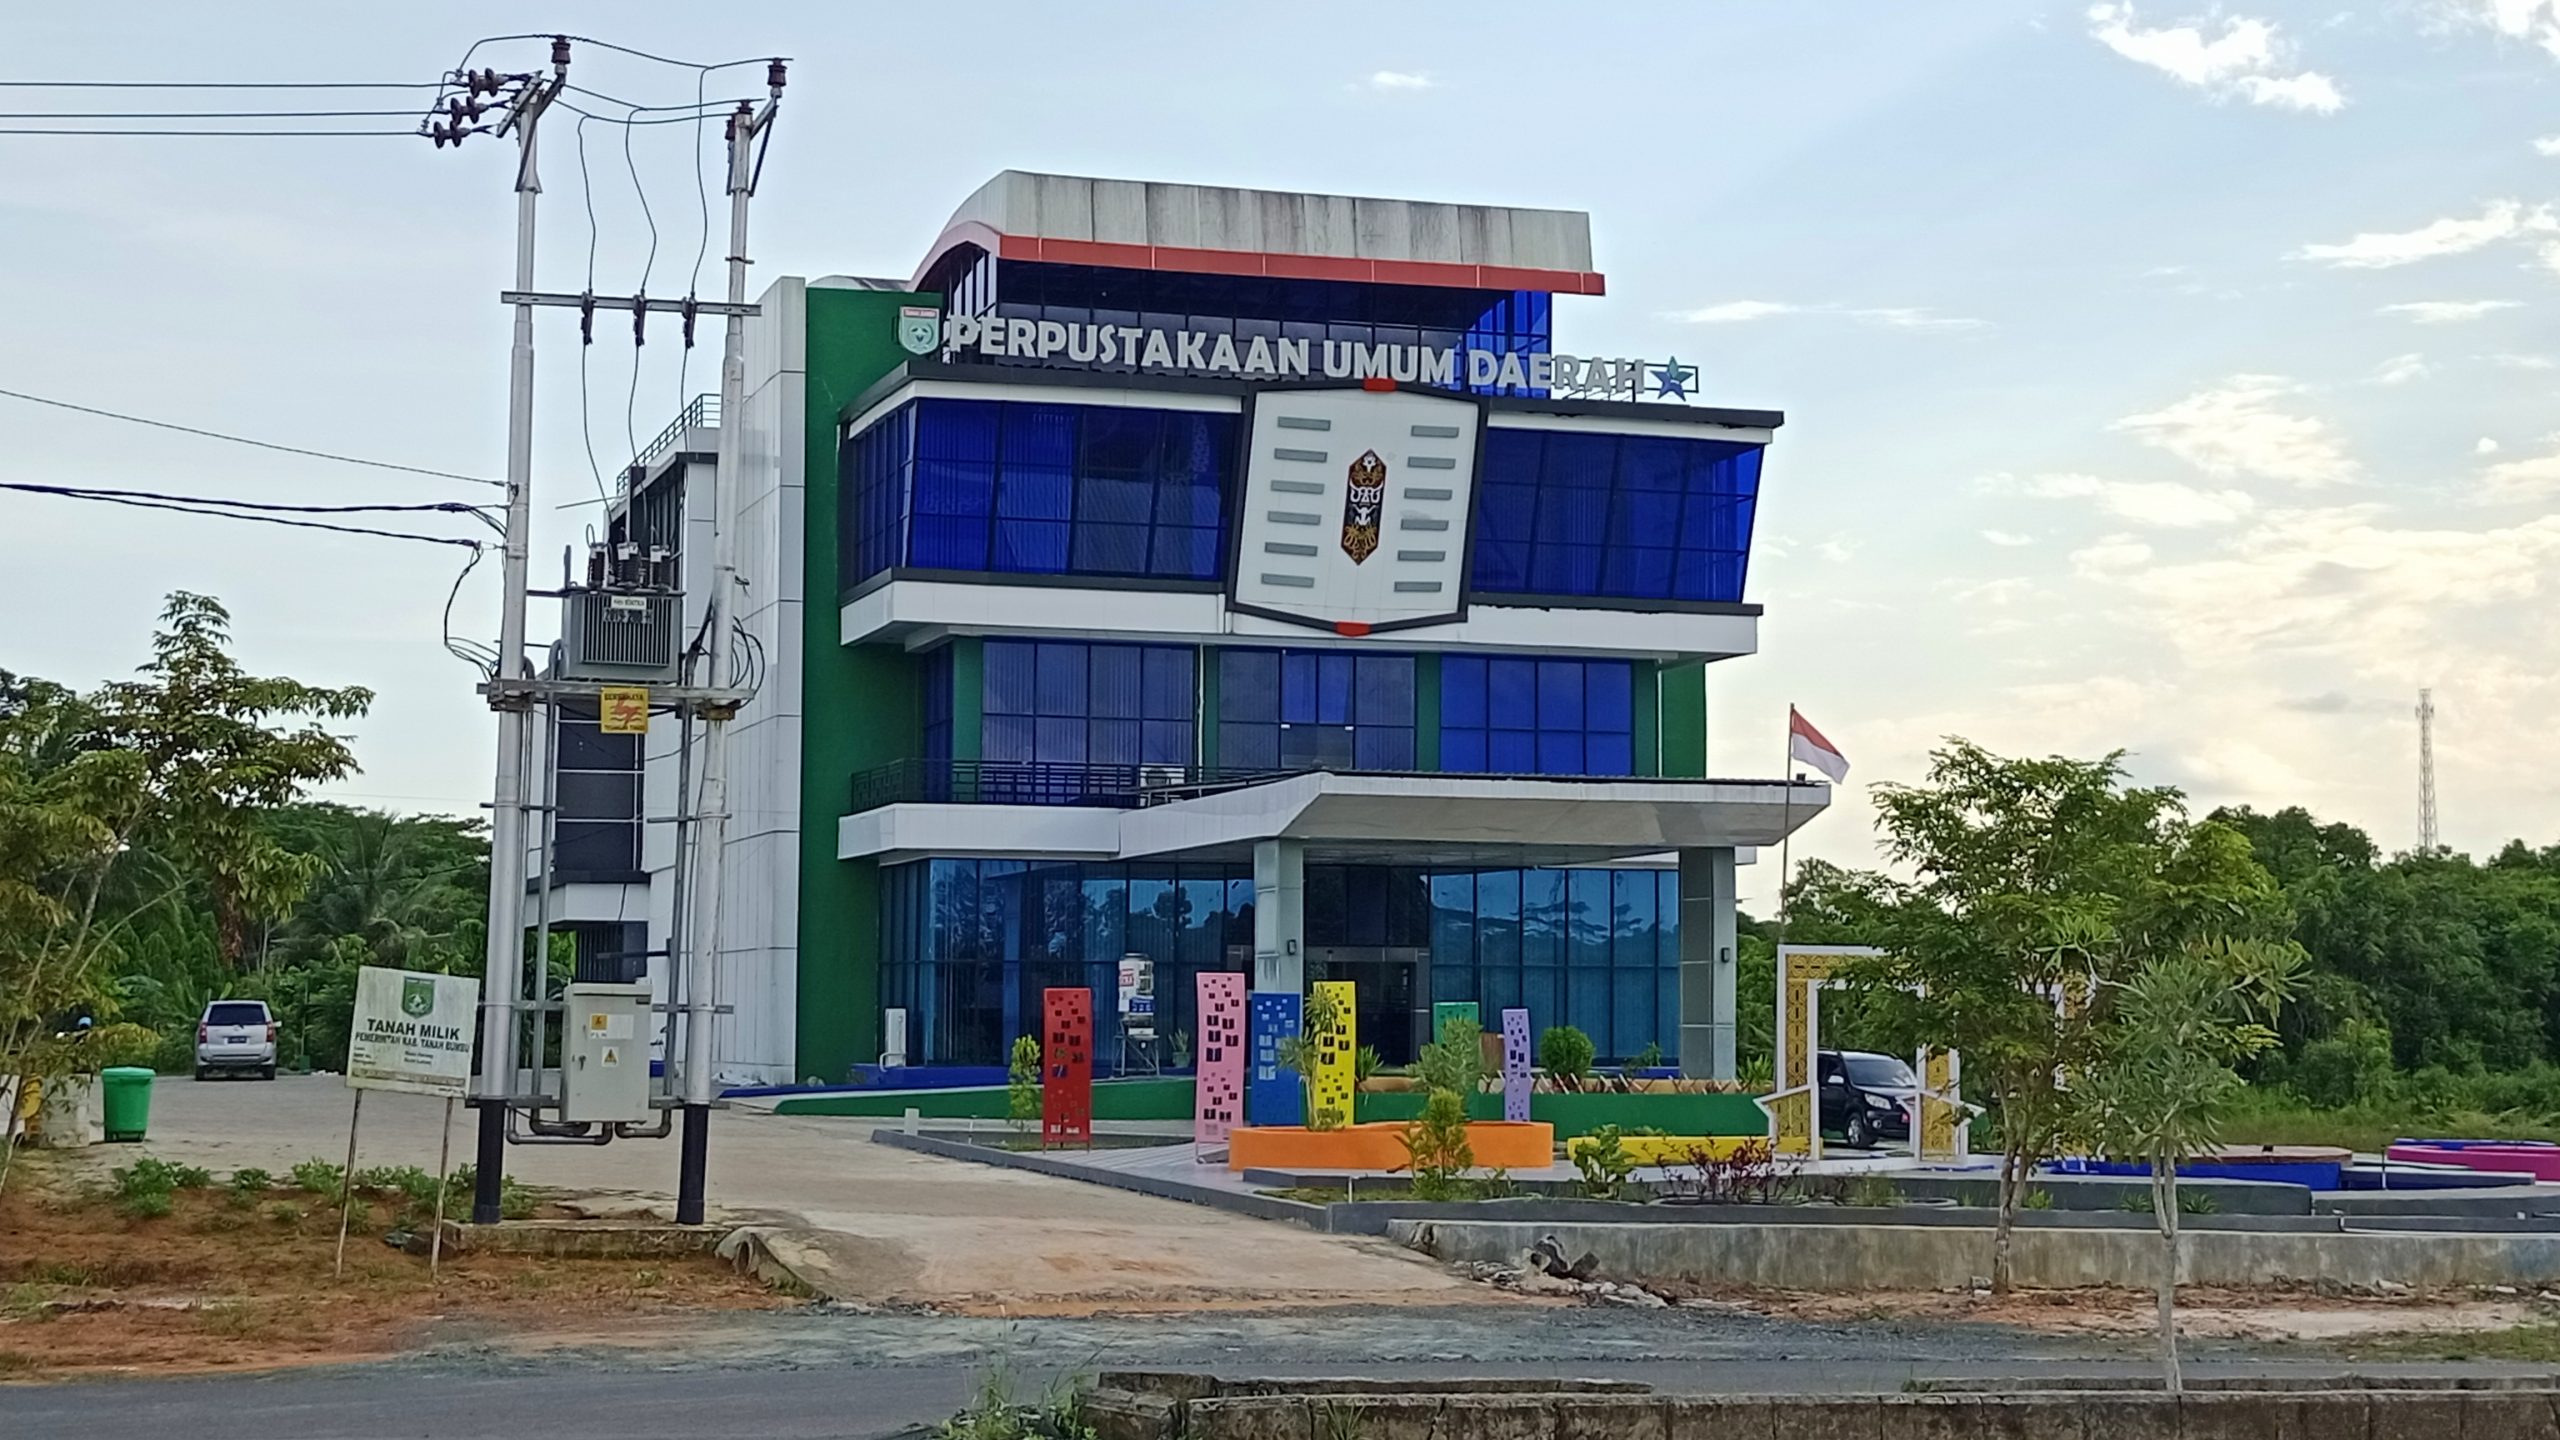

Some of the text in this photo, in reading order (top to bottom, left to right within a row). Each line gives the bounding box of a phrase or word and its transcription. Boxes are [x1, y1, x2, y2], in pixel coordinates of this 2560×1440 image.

[949, 314, 1645, 395] PERPUSTAKAAN UMUM DAERAH
[367, 1018, 460, 1041] TANAH MILIK
